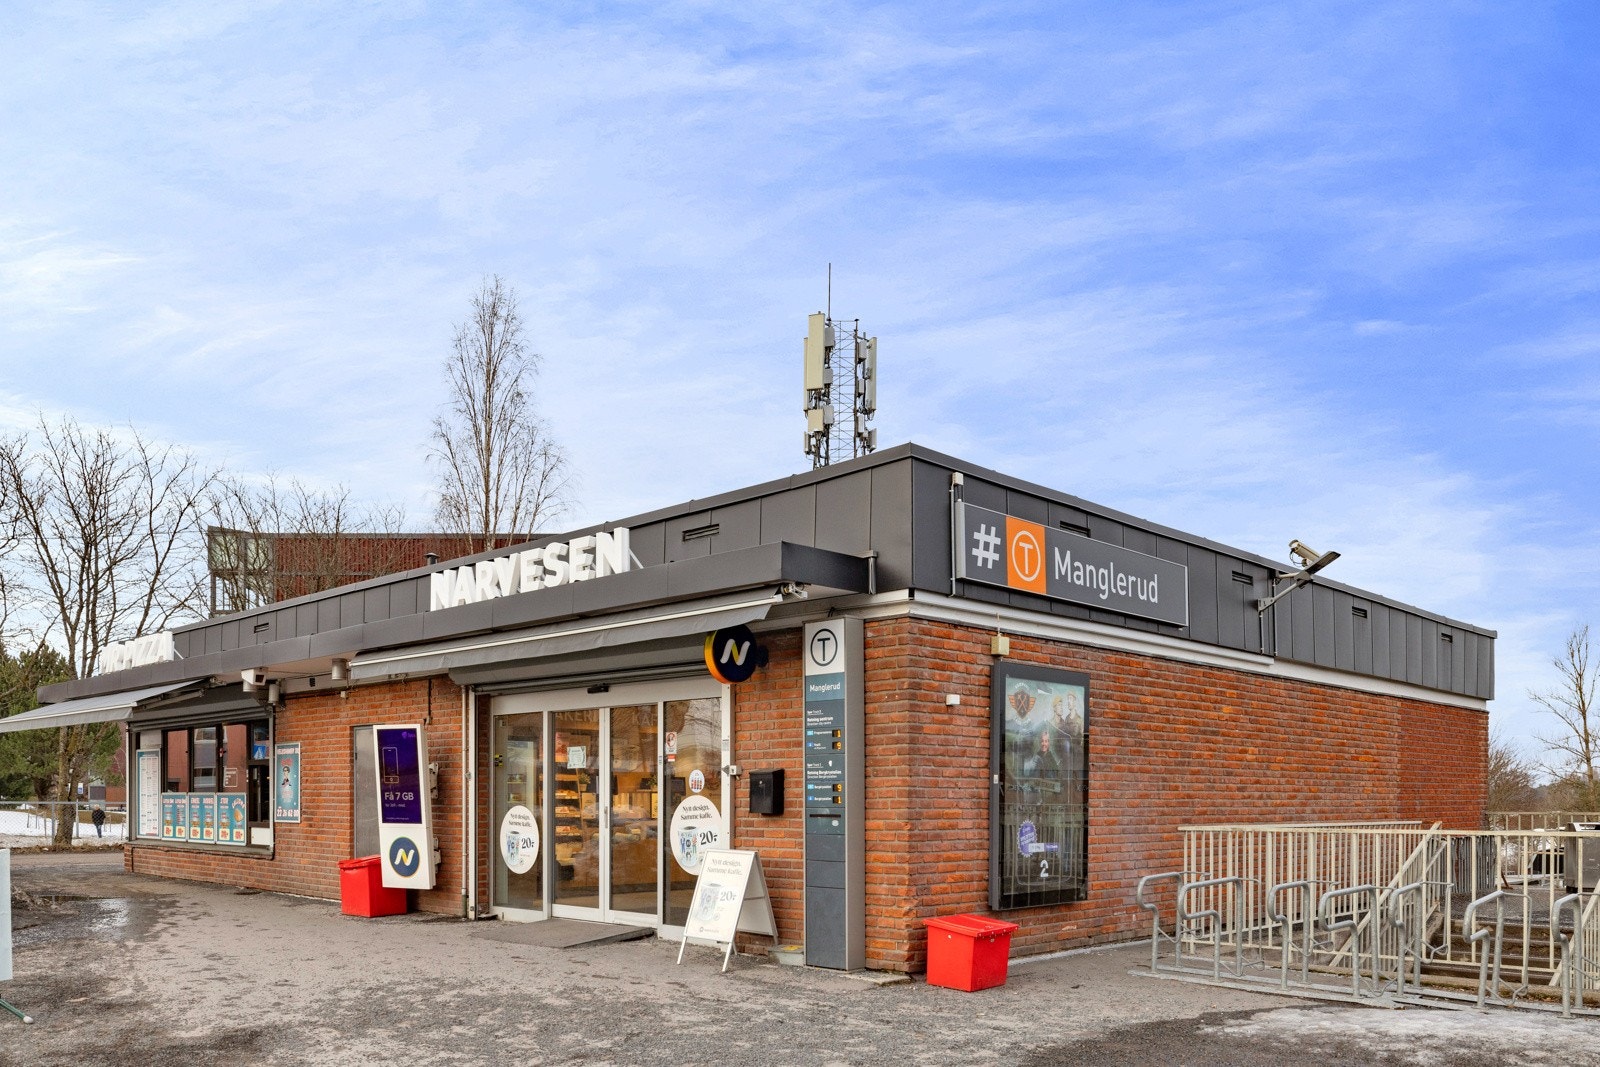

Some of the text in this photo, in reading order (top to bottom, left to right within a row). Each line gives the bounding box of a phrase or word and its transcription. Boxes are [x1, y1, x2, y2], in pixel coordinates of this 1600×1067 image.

[430, 526, 631, 611] NARVESEN
[1054, 546, 1158, 604] Manglerud
[809, 682, 841, 693] Manglerud
[384, 791, 414, 801] Få 7 GB
[1040, 859, 1049, 878] 2
